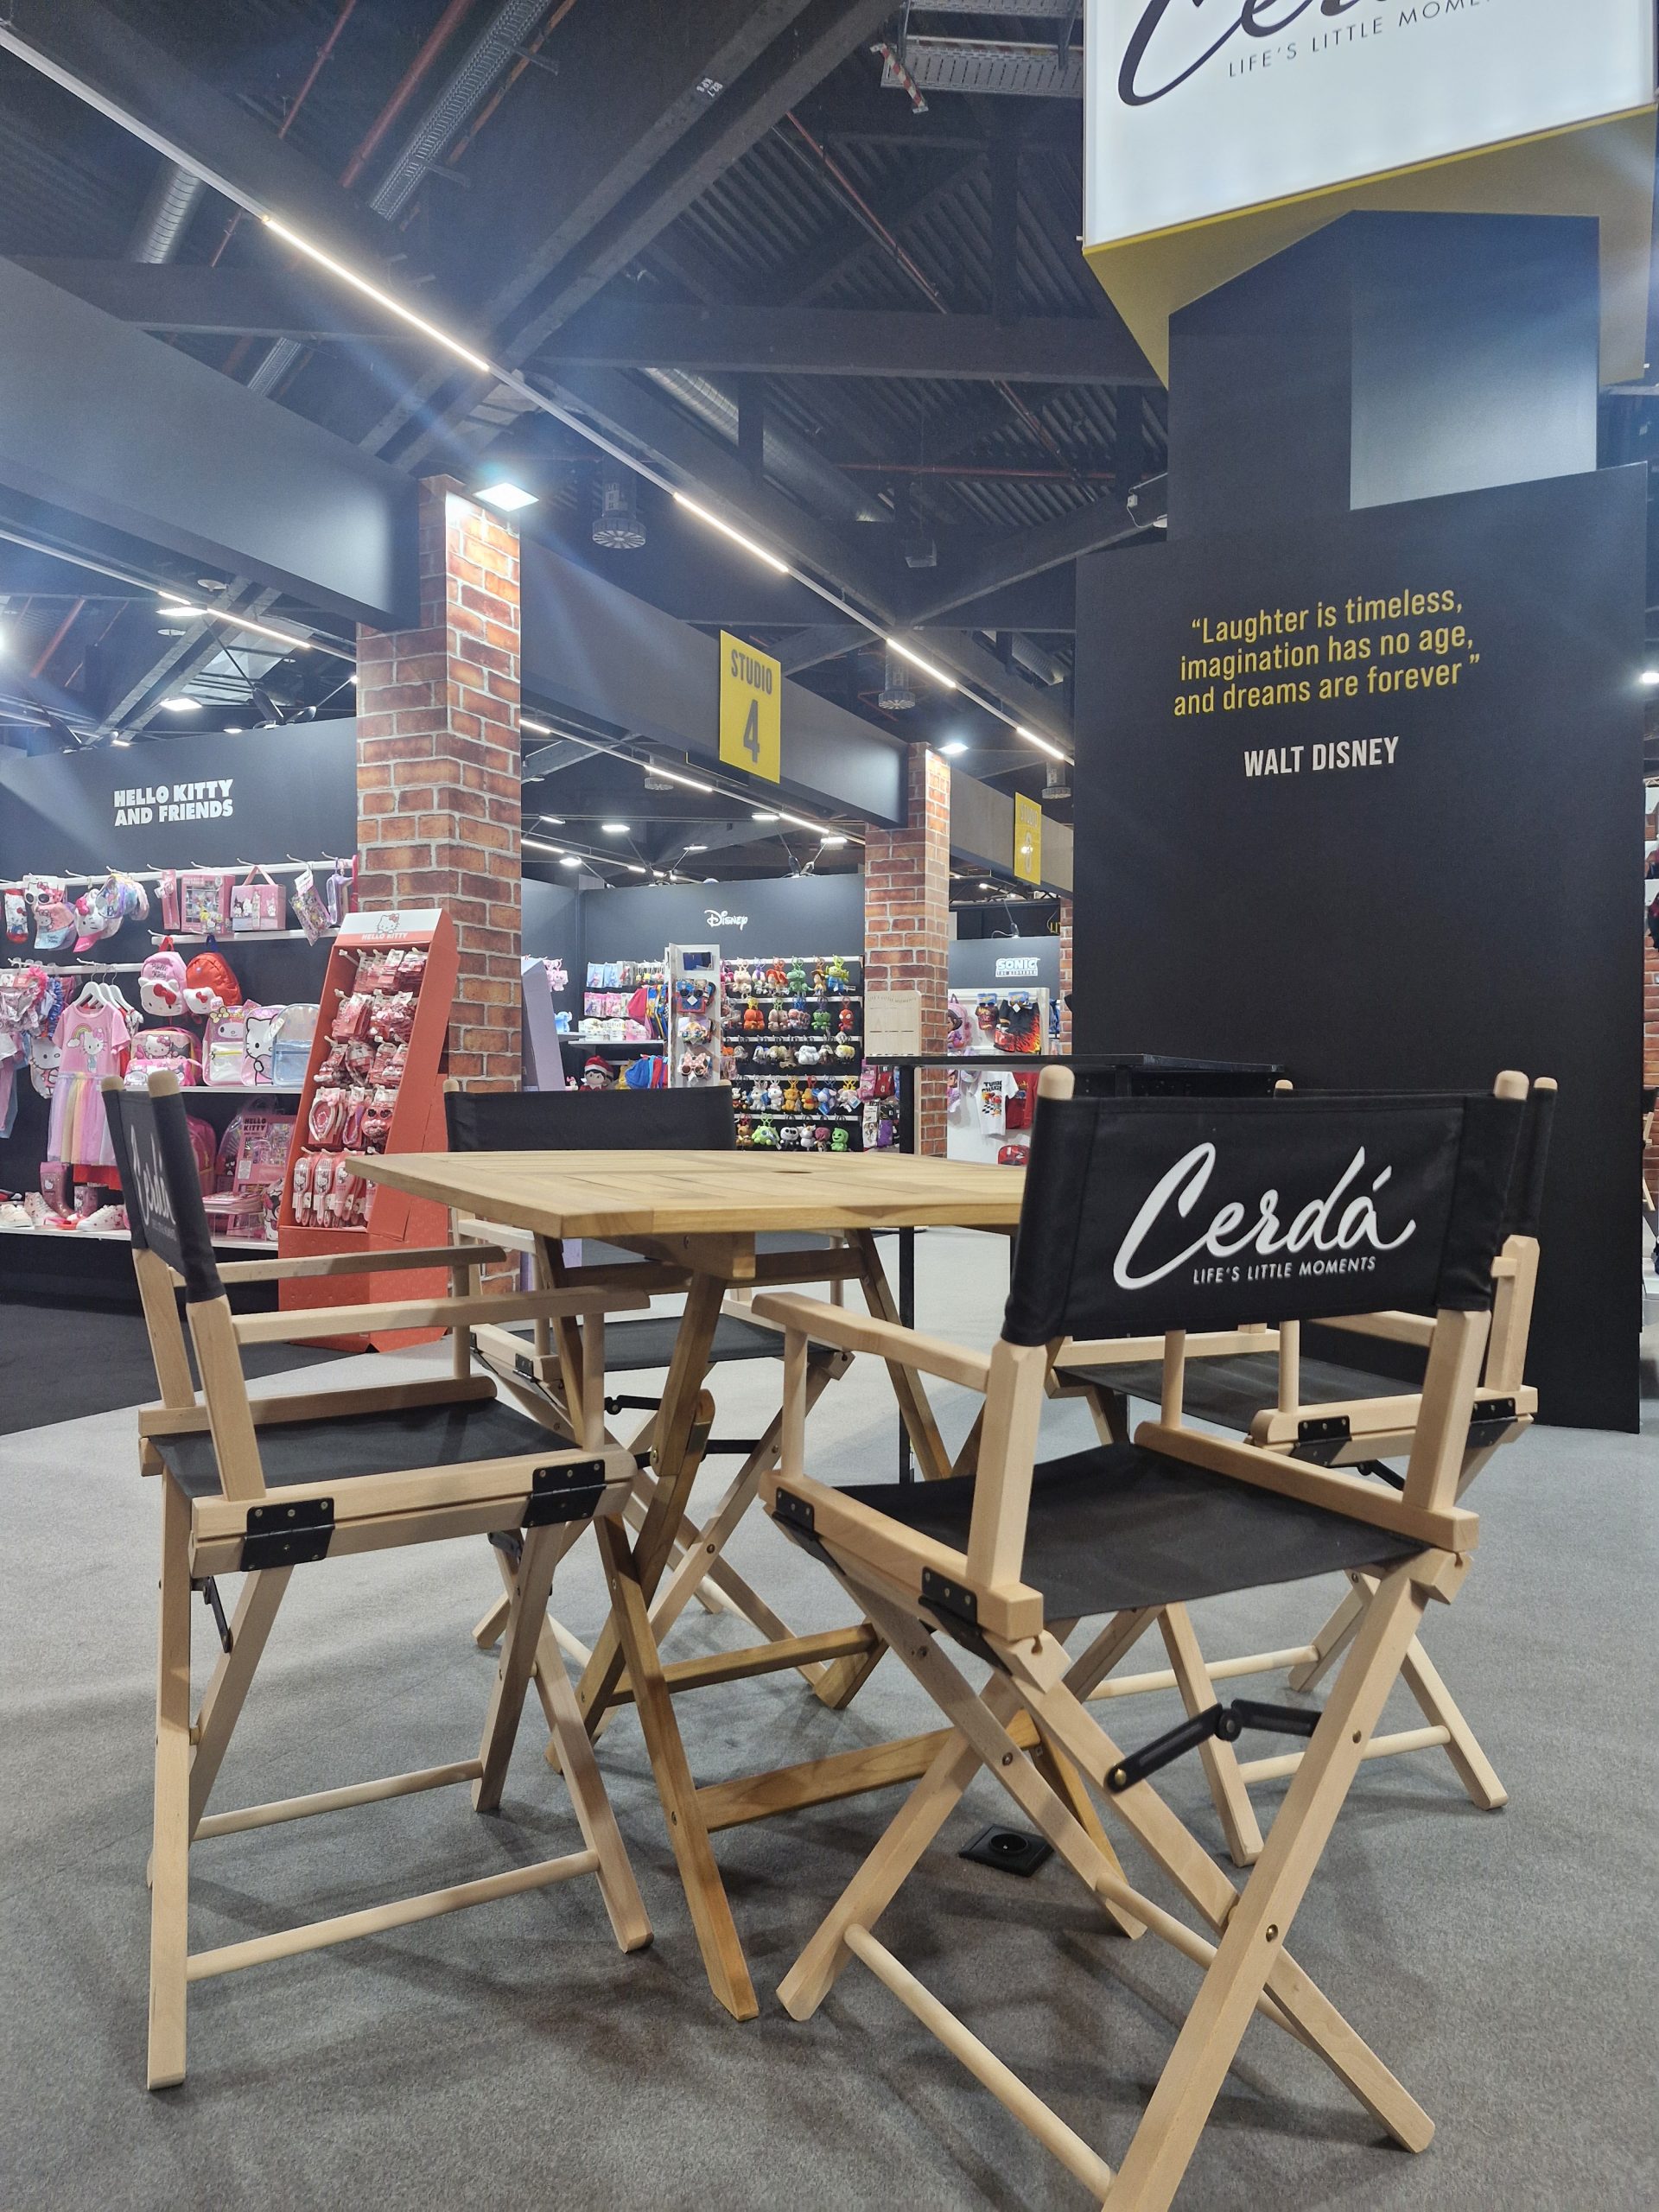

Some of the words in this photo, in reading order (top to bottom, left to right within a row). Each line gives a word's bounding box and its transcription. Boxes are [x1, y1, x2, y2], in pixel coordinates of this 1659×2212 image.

[1229, 42, 1297, 77] LIFE'S
[1312, 16, 1382, 52] LITTLE
[1317, 601, 1338, 628] is
[1345, 588, 1463, 624] timeless,
[730, 648, 773, 696] STUDIO
[1180, 643, 1319, 682] imagination
[1328, 636, 1371, 663] has
[1380, 632, 1410, 656] no
[1419, 625, 1473, 654] age,
[1173, 686, 1214, 716] and
[1223, 682, 1311, 711] dreams
[1319, 675, 1358, 700] are
[743, 698, 760, 764] 4
[1243, 745, 1305, 777] WALT
[1313, 736, 1399, 772] DISNEY
[113, 785, 169, 808] HELLO
[173, 779, 233, 803] KITTY
[114, 806, 153, 827] AND
[158, 798, 233, 823] FRIENDS
[1020, 801, 1039, 829] STUDIO
[703, 909, 748, 931] Disney
[997, 957, 1038, 970] SONIC
[1113, 1141, 1417, 1290] Cerdá
[1193, 1265, 1241, 1285] LIFE'S
[1247, 1262, 1293, 1281] LITTLE
[1298, 1255, 1376, 1277] MOMENTS
